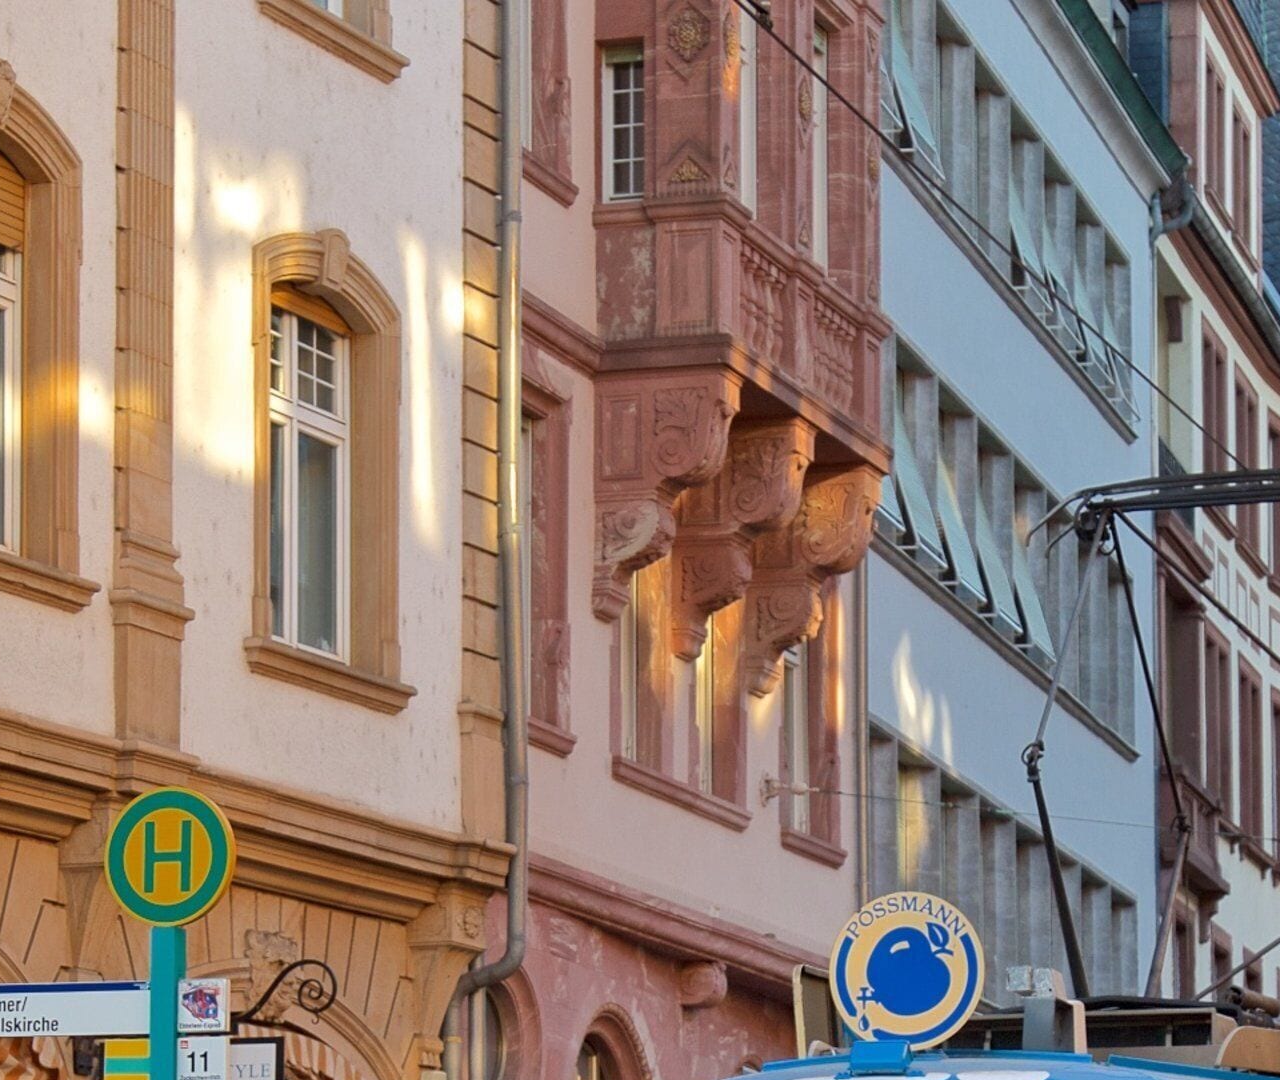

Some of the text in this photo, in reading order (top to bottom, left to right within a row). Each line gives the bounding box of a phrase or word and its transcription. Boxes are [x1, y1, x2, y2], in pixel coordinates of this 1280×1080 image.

[144, 820, 191, 893] H
[846, 896, 965, 938] POSSMANN
[187, 1051, 208, 1073] 11
[230, 1063, 271, 1079] YLE
